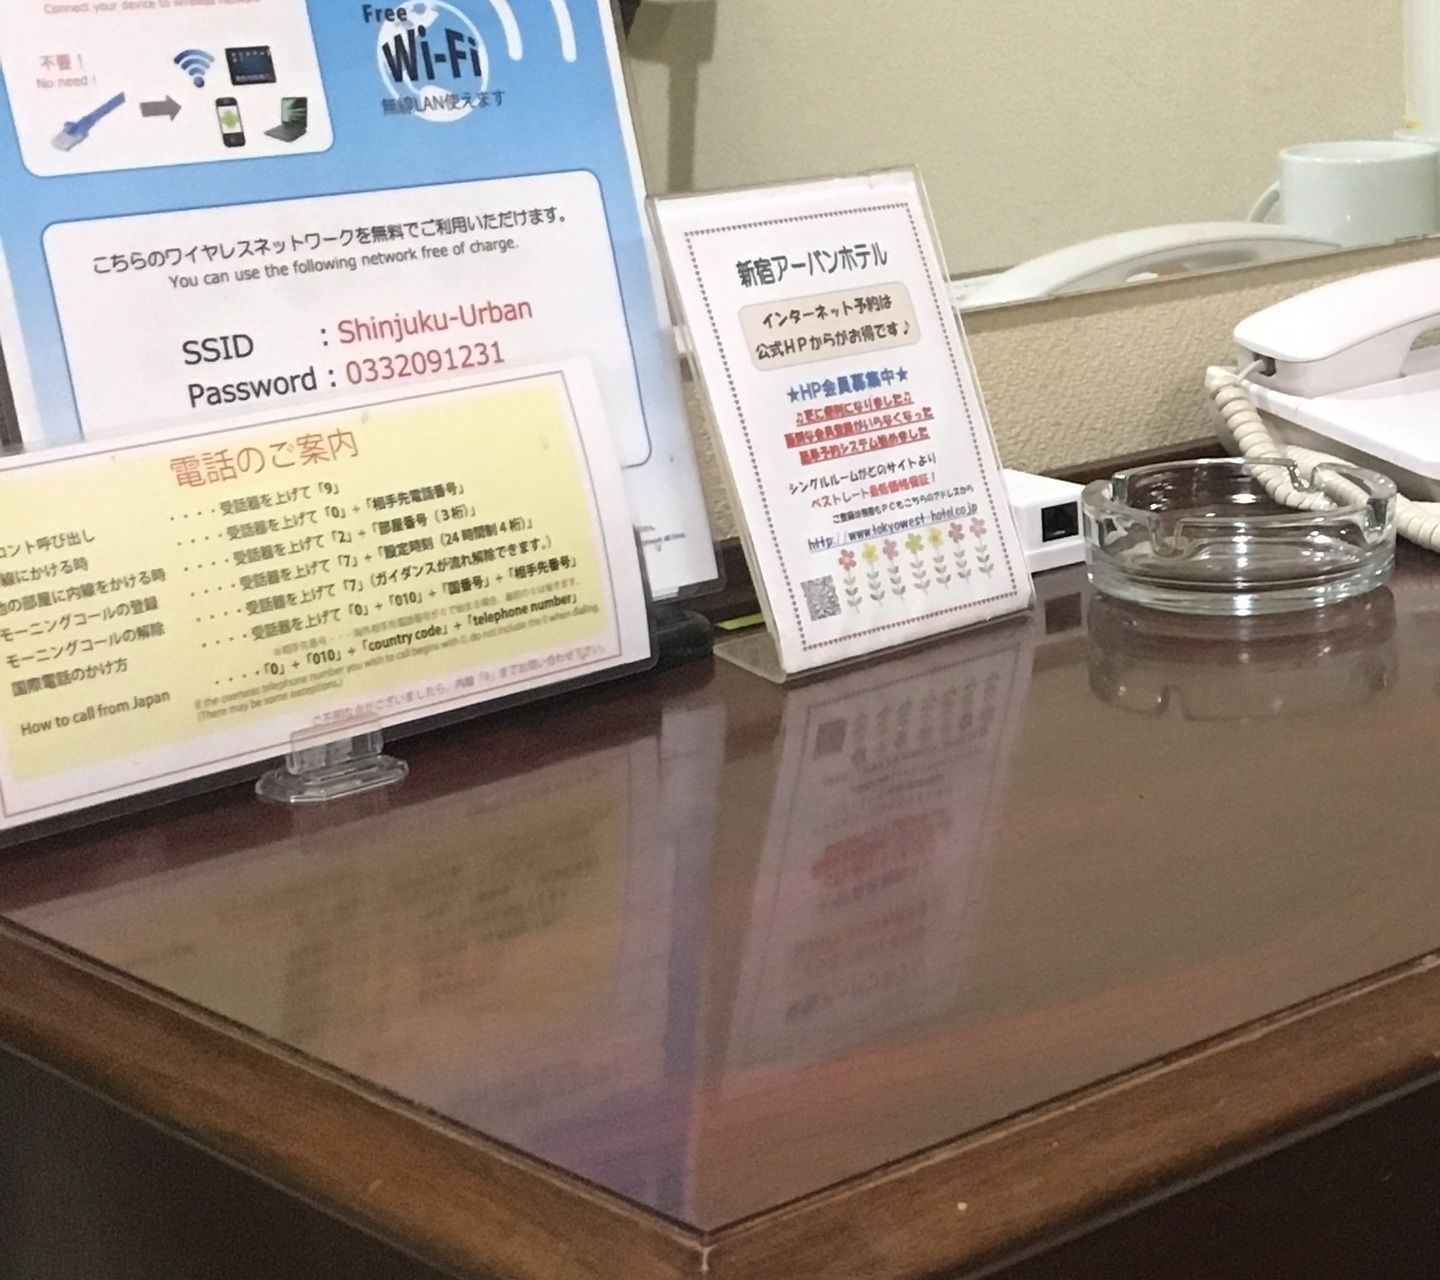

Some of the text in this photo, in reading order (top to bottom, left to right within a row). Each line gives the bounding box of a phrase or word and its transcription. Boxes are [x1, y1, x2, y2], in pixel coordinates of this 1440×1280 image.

[361, 3, 408, 23] Free
[381, 24, 483, 83] Wi-Fi
[92, 206, 566, 274] こちらのワイヤレスネットワークを無料でご利用いただけます。
[167, 274, 199, 289] You
[203, 271, 230, 285] can
[235, 268, 261, 282] use
[264, 263, 289, 279] the
[293, 254, 357, 274] following
[361, 247, 418, 267] network
[421, 244, 449, 260] free
[452, 240, 466, 256] of
[735, 241, 888, 288] 新宿アーバンホテル
[182, 333, 254, 365] SSID
[337, 300, 534, 344] Shinjuku-Urban
[762, 294, 892, 329] インターネット予約は
[187, 365, 318, 409] Password
[345, 340, 506, 385] 0332091231
[169, 428, 359, 488] 電話のご案内
[20, 719, 53, 737] How
[54, 715, 71, 729] to
[72, 705, 96, 724] call
[97, 699, 131, 719] from
[131, 690, 171, 710] Japan
